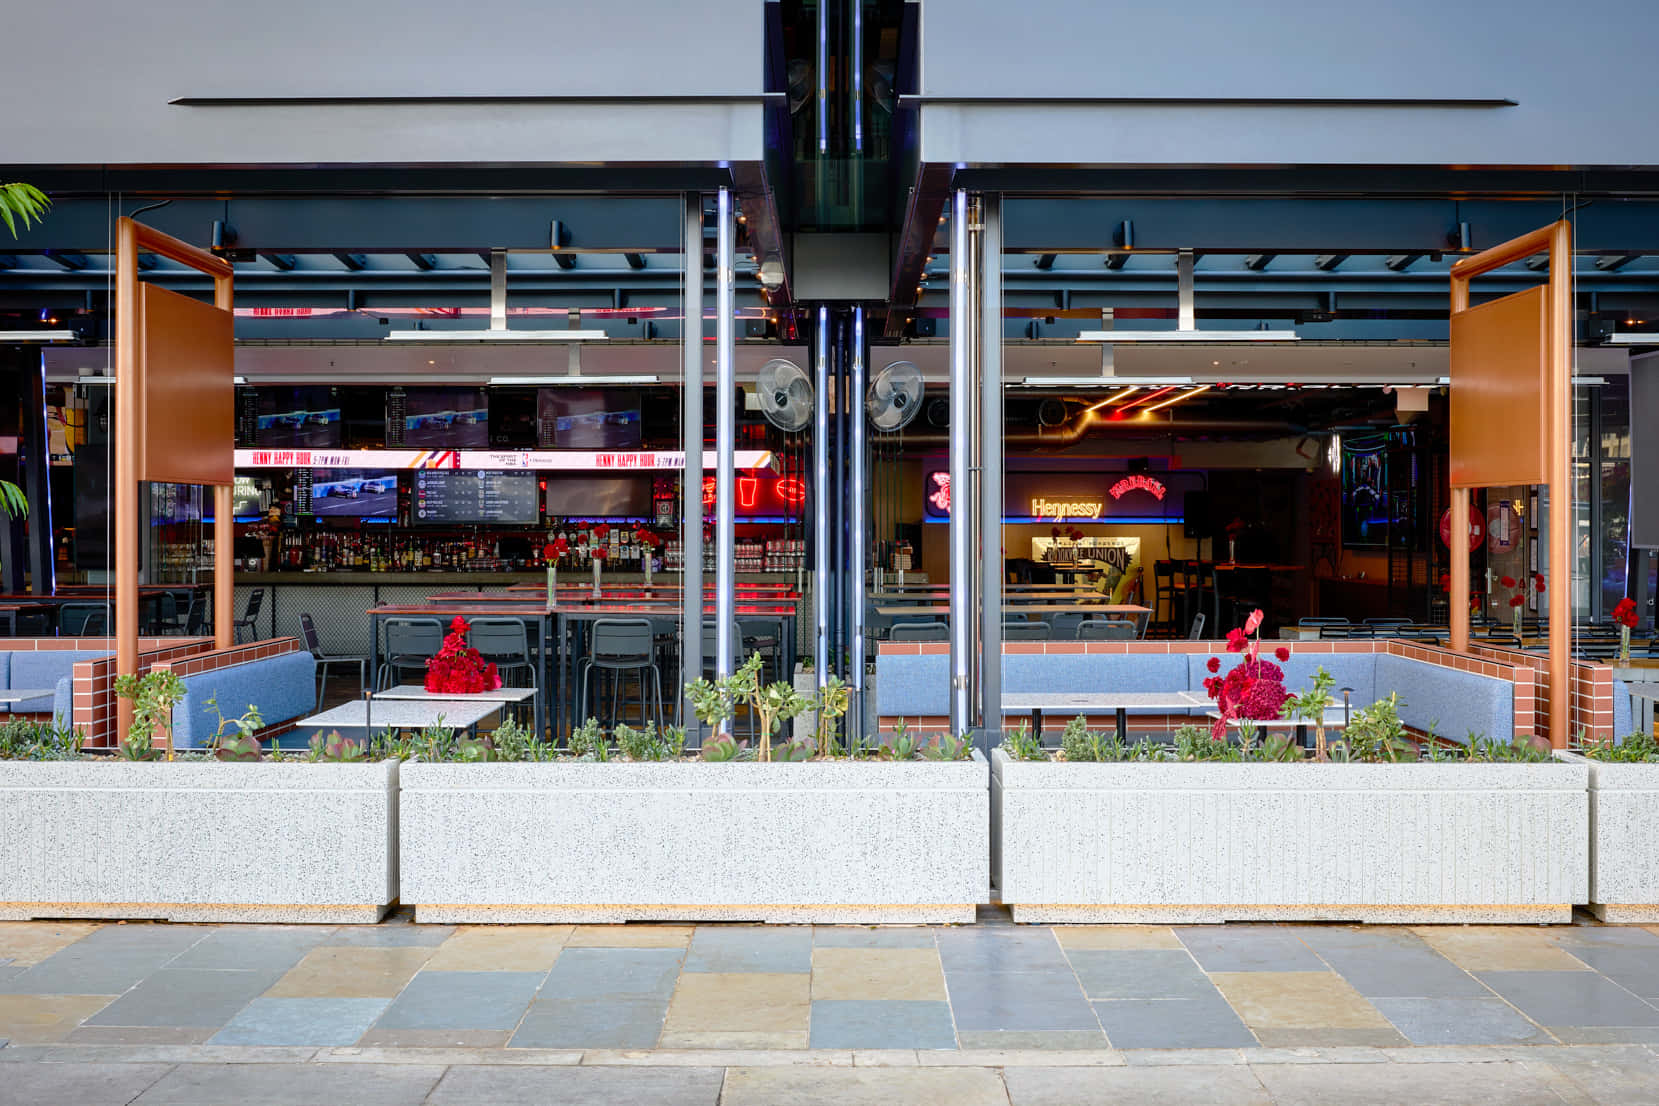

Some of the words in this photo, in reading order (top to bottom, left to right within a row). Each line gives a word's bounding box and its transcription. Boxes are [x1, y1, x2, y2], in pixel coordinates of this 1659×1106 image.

[252, 452, 271, 464] HENNY
[273, 452, 293, 464] HAPPY
[296, 452, 311, 464] HOUR
[596, 454, 615, 467] HENNY
[617, 454, 638, 467] HAPPY
[640, 454, 655, 467] HOUR
[1032, 499, 1102, 522] Hennessy
[1088, 548, 1125, 571] UNION
